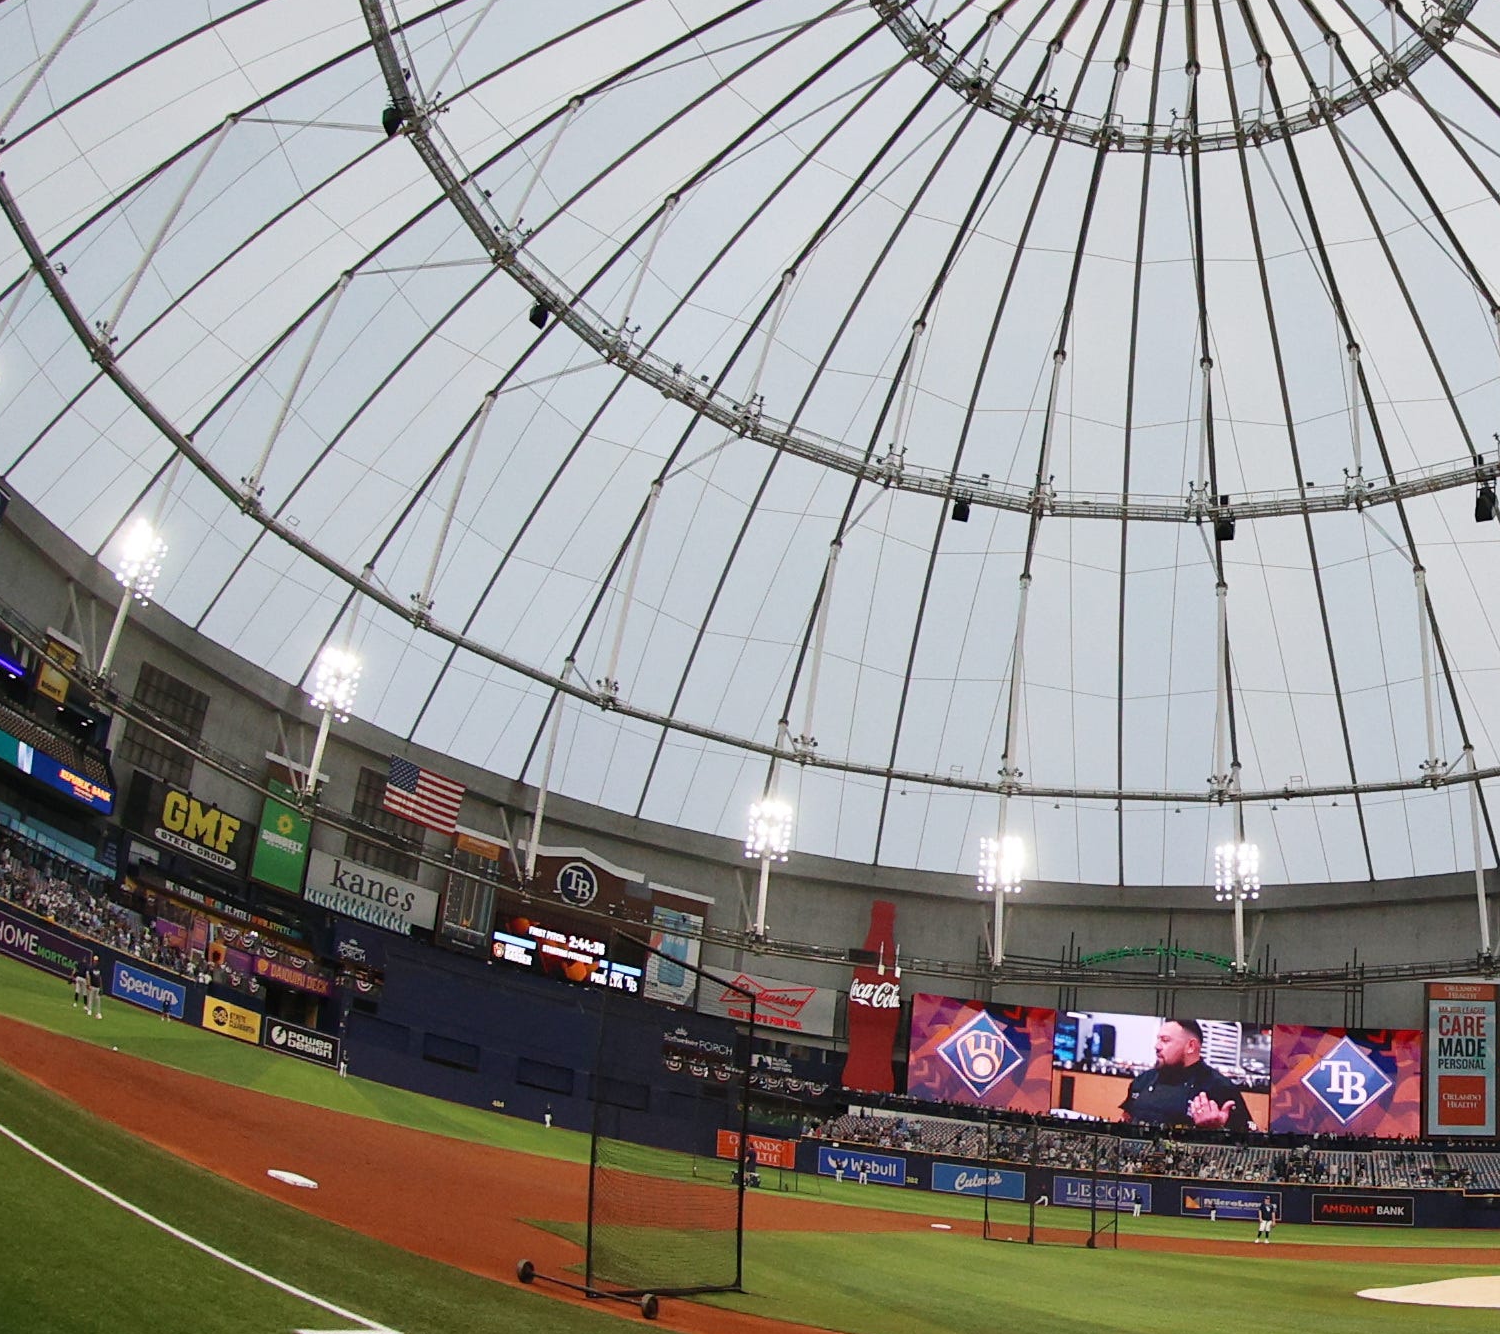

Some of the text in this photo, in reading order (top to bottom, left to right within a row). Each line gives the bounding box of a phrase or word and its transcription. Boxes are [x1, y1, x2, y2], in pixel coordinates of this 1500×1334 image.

[162, 790, 241, 854] GMF
[160, 831, 232, 867] STEEL GROUP
[329, 859, 415, 912] kanes
[566, 869, 591, 900] TB
[119, 970, 174, 1005] Spectrum
[307, 973, 329, 994] DECK
[624, 975, 638, 993] TB
[1444, 985, 1481, 993] ORLANDO
[1448, 992, 1477, 1000] HEALTH
[1438, 1006, 1486, 1015] MAJOR LEAGUE
[1438, 1015, 1486, 1037] CARE
[1438, 1038, 1486, 1058] MADE
[1438, 1059, 1486, 1070] PERSONAL
[1319, 1060, 1368, 1105] TB
[1442, 1093, 1481, 1101] ORLANDO
[1447, 1100, 1477, 1109] HEALTH
[851, 1157, 897, 1177] Webull
[1321, 1204, 1405, 1216] AMERANT BANK
